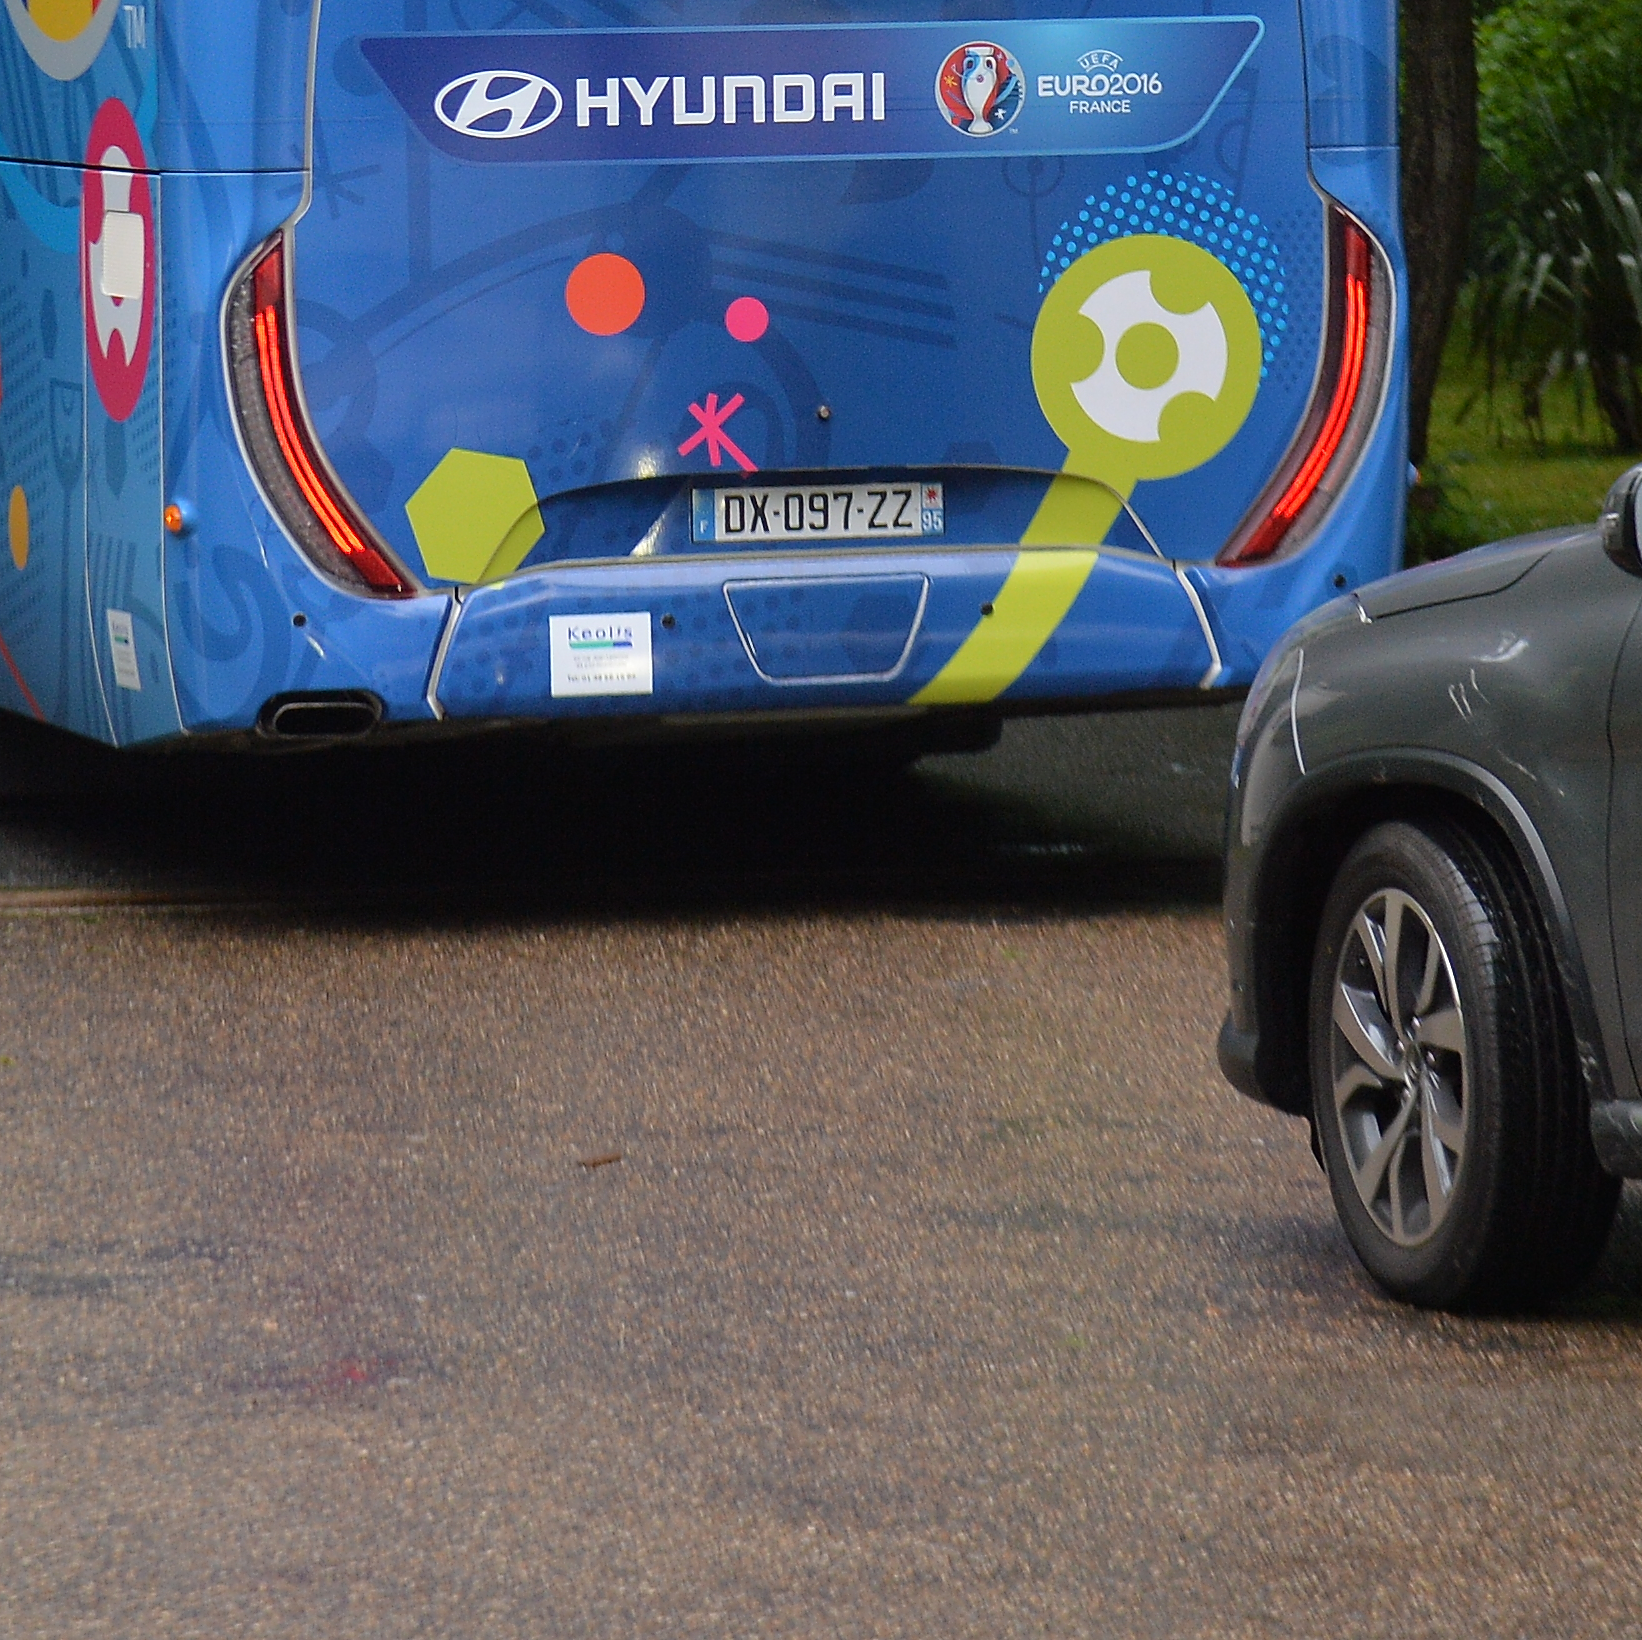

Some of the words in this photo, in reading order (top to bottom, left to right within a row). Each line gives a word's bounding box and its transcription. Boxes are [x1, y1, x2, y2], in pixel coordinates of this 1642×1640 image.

[1080, 52, 1119, 70] UEFA
[1037, 72, 1163, 97] EURO2016
[576, 71, 886, 128] HYUNDAI
[1069, 100, 1131, 115] FRANCE
[723, 490, 913, 533] DX-097-ZZ
[921, 509, 943, 530] 95
[567, 626, 633, 641] Keolis
